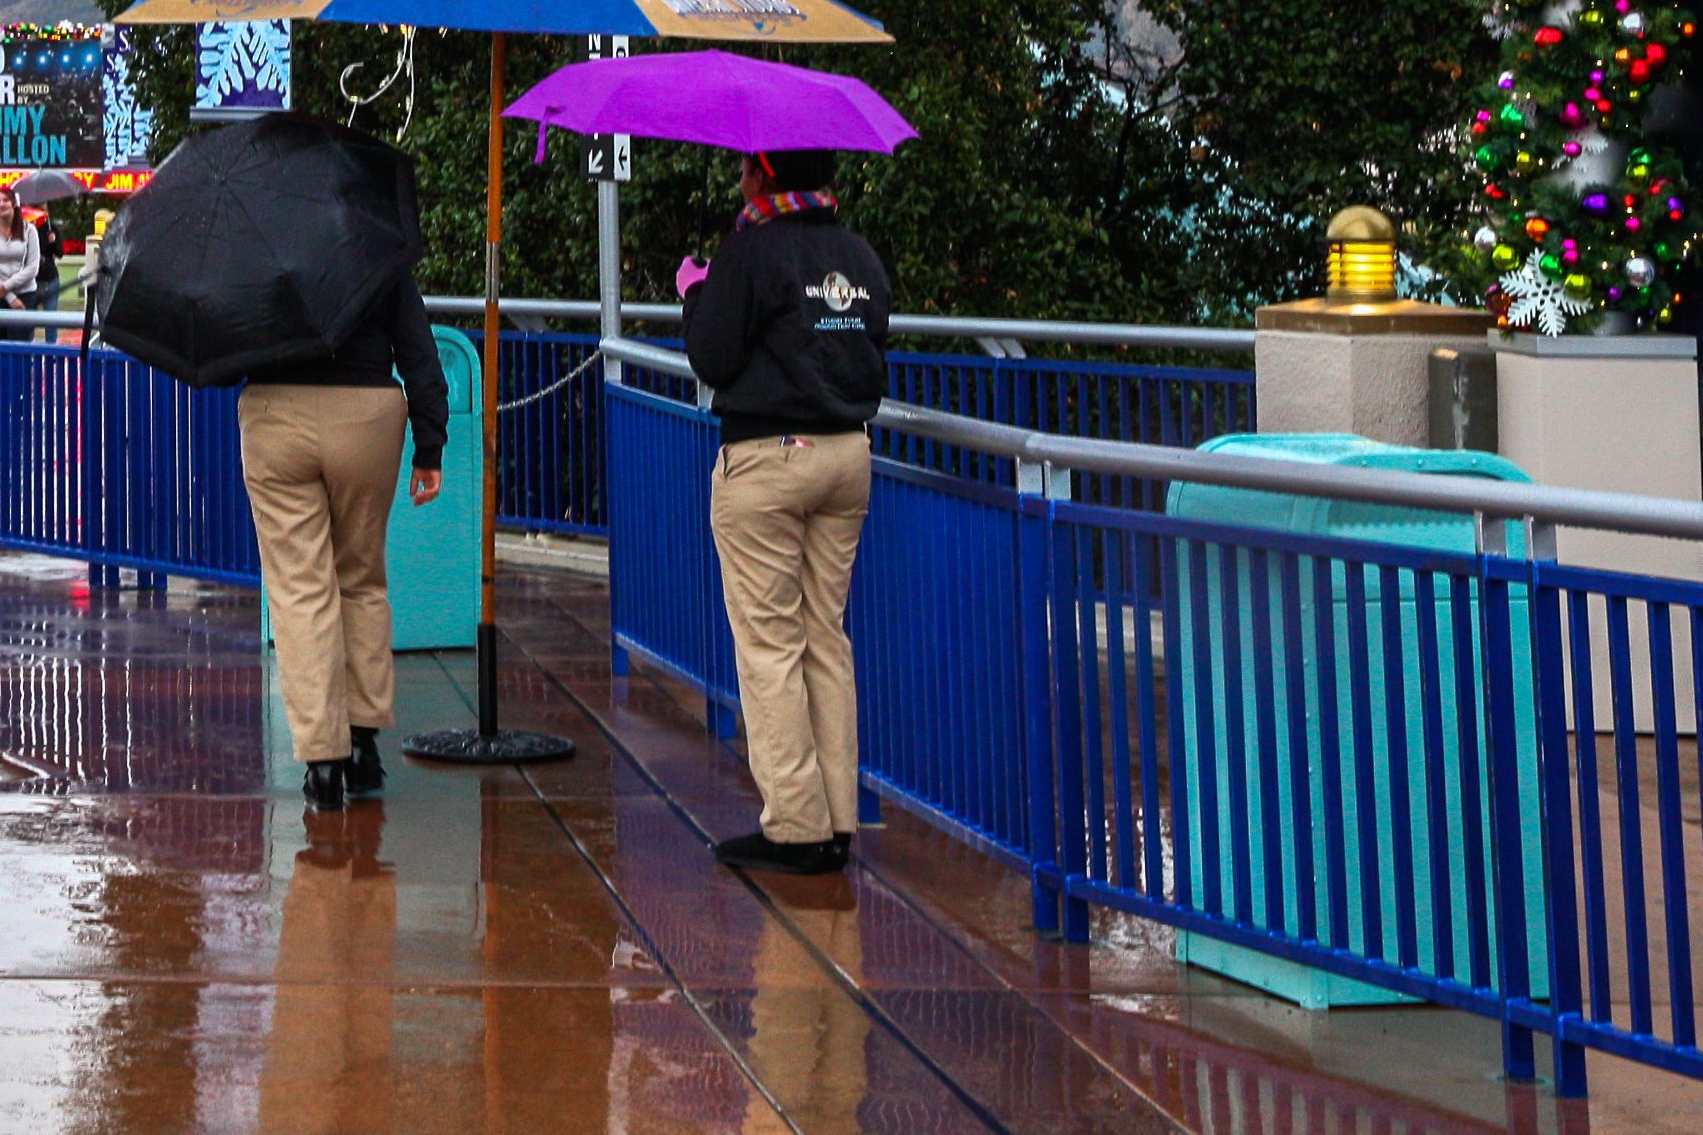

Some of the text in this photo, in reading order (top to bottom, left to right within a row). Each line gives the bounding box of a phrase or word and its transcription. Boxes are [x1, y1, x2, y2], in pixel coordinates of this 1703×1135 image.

[17, 83, 50, 95] HOSTED
[17, 95, 29, 105] BY
[805, 284, 871, 301] UNIVERSAL
